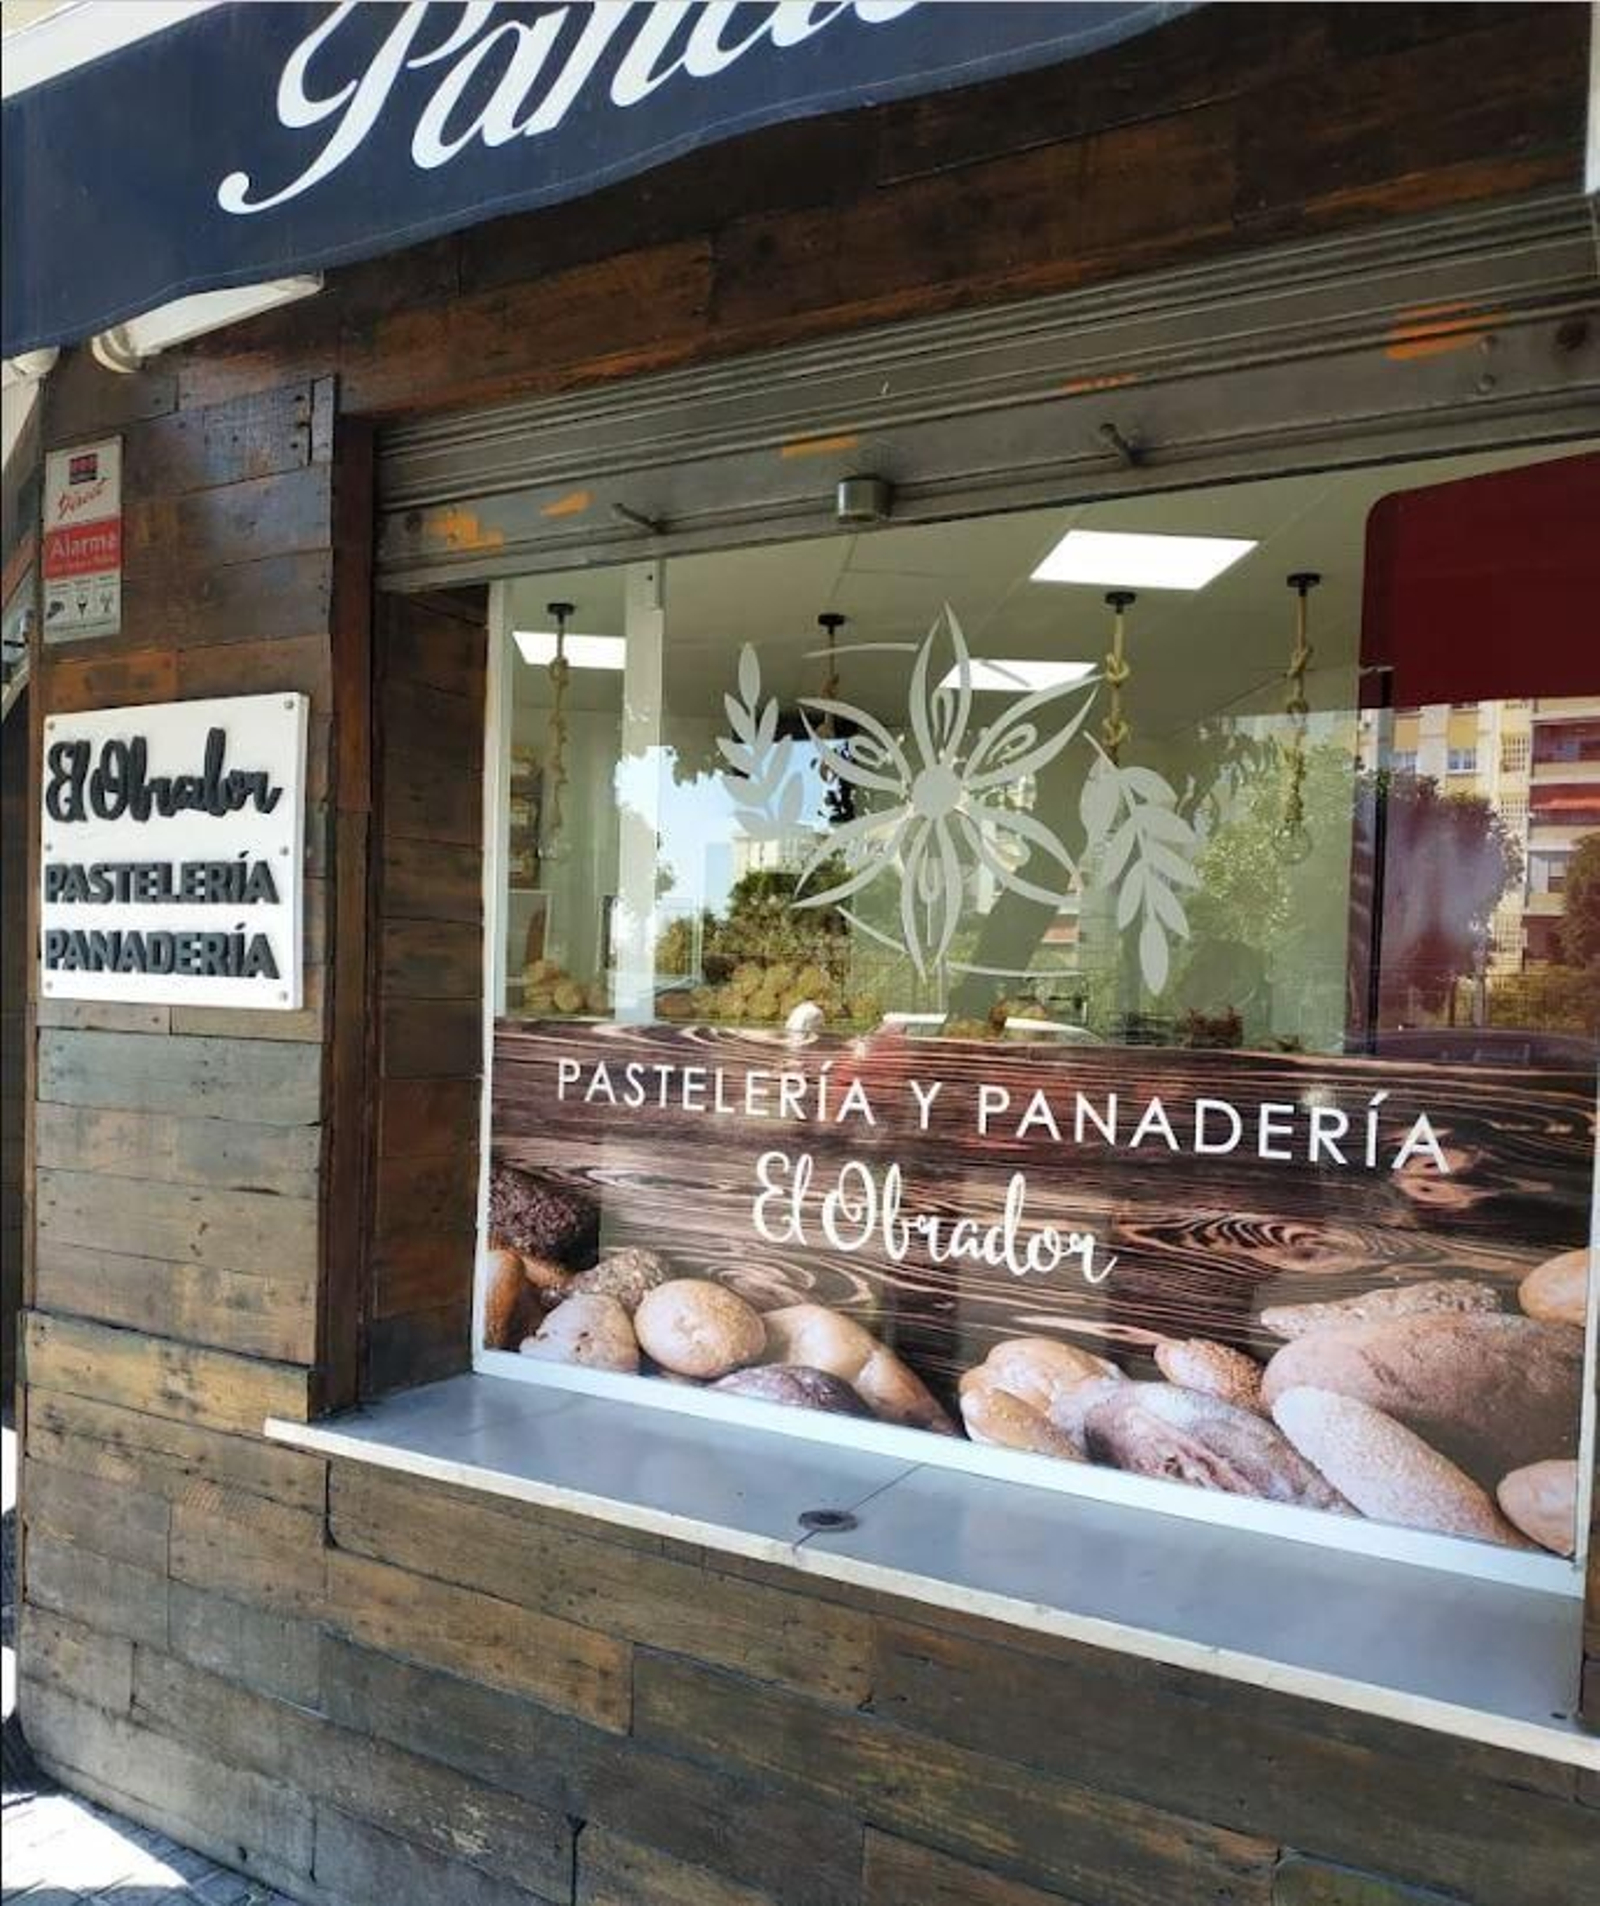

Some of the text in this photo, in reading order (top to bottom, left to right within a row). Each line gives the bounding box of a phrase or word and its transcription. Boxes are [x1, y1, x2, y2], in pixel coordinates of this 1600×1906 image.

[91, 727, 284, 823] Obrador
[45, 850, 281, 905] PASTELERÍA
[45, 922, 281, 980] PANADERÍA
[557, 1058, 1452, 1175] PASTELERÍA Y PANADERÍA
[752, 1150, 1118, 1284] El Obrador
